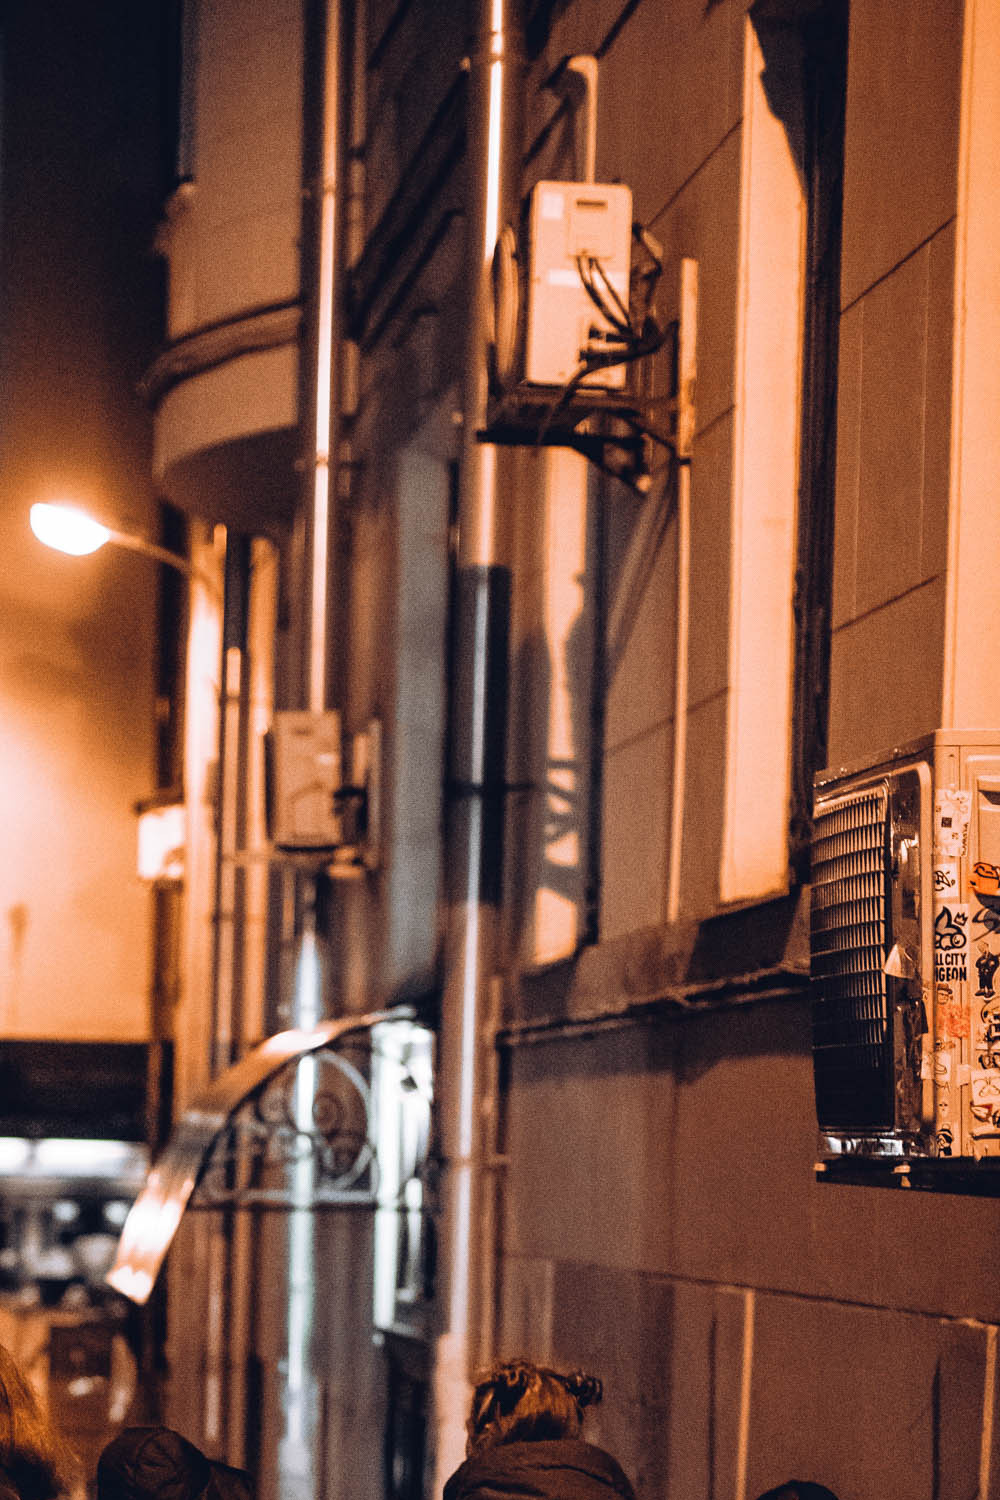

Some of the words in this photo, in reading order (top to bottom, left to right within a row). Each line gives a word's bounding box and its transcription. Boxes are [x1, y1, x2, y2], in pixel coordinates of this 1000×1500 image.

[935, 952, 944, 966] LL
[945, 952, 967, 966] CITY
[935, 966, 967, 982] IGEON
